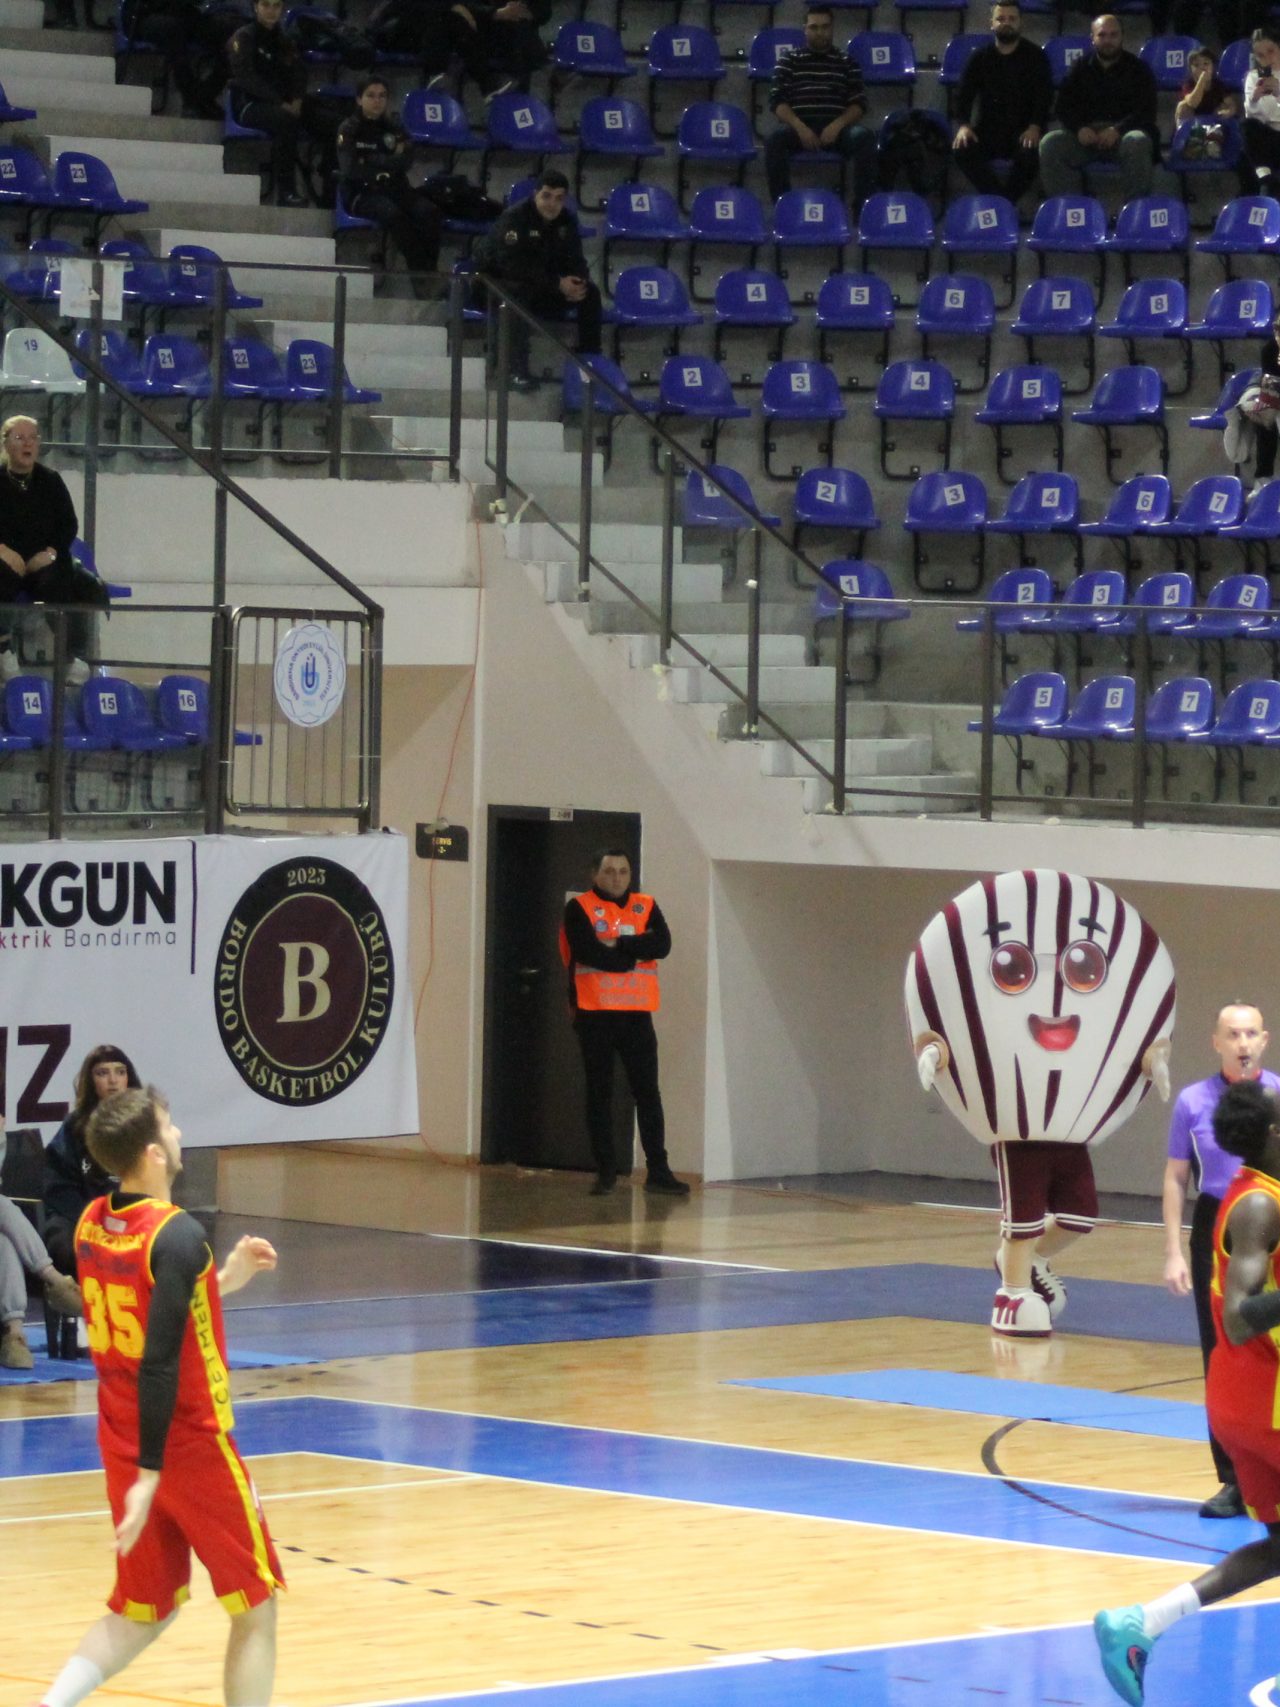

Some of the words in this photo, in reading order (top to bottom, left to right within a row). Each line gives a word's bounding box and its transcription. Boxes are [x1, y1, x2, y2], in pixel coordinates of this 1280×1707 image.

[675, 41, 687, 54] 7
[875, 49, 887, 62] 9
[1168, 52, 1182, 66] 12
[428, 106, 439, 120] 3
[518, 111, 530, 124] 4
[608, 112, 619, 126] 5
[714, 121, 726, 136] 6
[0, 162, 16, 175] 22
[71, 167, 85, 179] 23
[634, 196, 646, 209] 4
[719, 203, 730, 217] 5
[807, 205, 820, 220] 6
[890, 205, 902, 222] 7
[1070, 210, 1082, 224] 9
[1253, 210, 1265, 223] 11
[982, 211, 994, 226] 8
[1151, 211, 1167, 225] 10
[644, 283, 655, 297] 3
[750, 285, 763, 299] 4
[854, 289, 866, 303] 5
[948, 291, 961, 306] 6
[1056, 293, 1067, 307] 7
[1154, 297, 1165, 312] 8
[1243, 302, 1253, 316] 9
[160, 352, 173, 365] 21
[234, 352, 248, 366] 22
[302, 357, 316, 371] 23
[687, 370, 699, 385] 2
[795, 375, 808, 390] 3
[914, 373, 927, 388] 4
[1026, 382, 1038, 396] 5
[820, 484, 832, 499] 2
[948, 487, 961, 502] 3
[1045, 490, 1057, 504] 4
[1140, 494, 1151, 508] 6
[1214, 495, 1225, 509] 7
[845, 578, 855, 592] 1
[1020, 585, 1032, 601] 2
[1095, 586, 1106, 602] 3
[1166, 587, 1176, 601] 4
[1242, 588, 1254, 603] 5
[24, 696, 40, 710] 14
[100, 696, 116, 711] 15
[180, 693, 195, 708] 16
[1038, 690, 1049, 705] 5
[1109, 690, 1120, 706] 6
[1186, 694, 1197, 709] 7
[1253, 701, 1265, 716] 8
[287, 867, 327, 887] 2023
[64, 928, 177, 948] Bandırma
[219, 916, 247, 1031] BORDO
[359, 911, 390, 1047] KULÜBÜ
[276, 941, 332, 1023] B
[231, 1035, 364, 1099] BASKETBOL
[82, 1276, 145, 1359] 35
